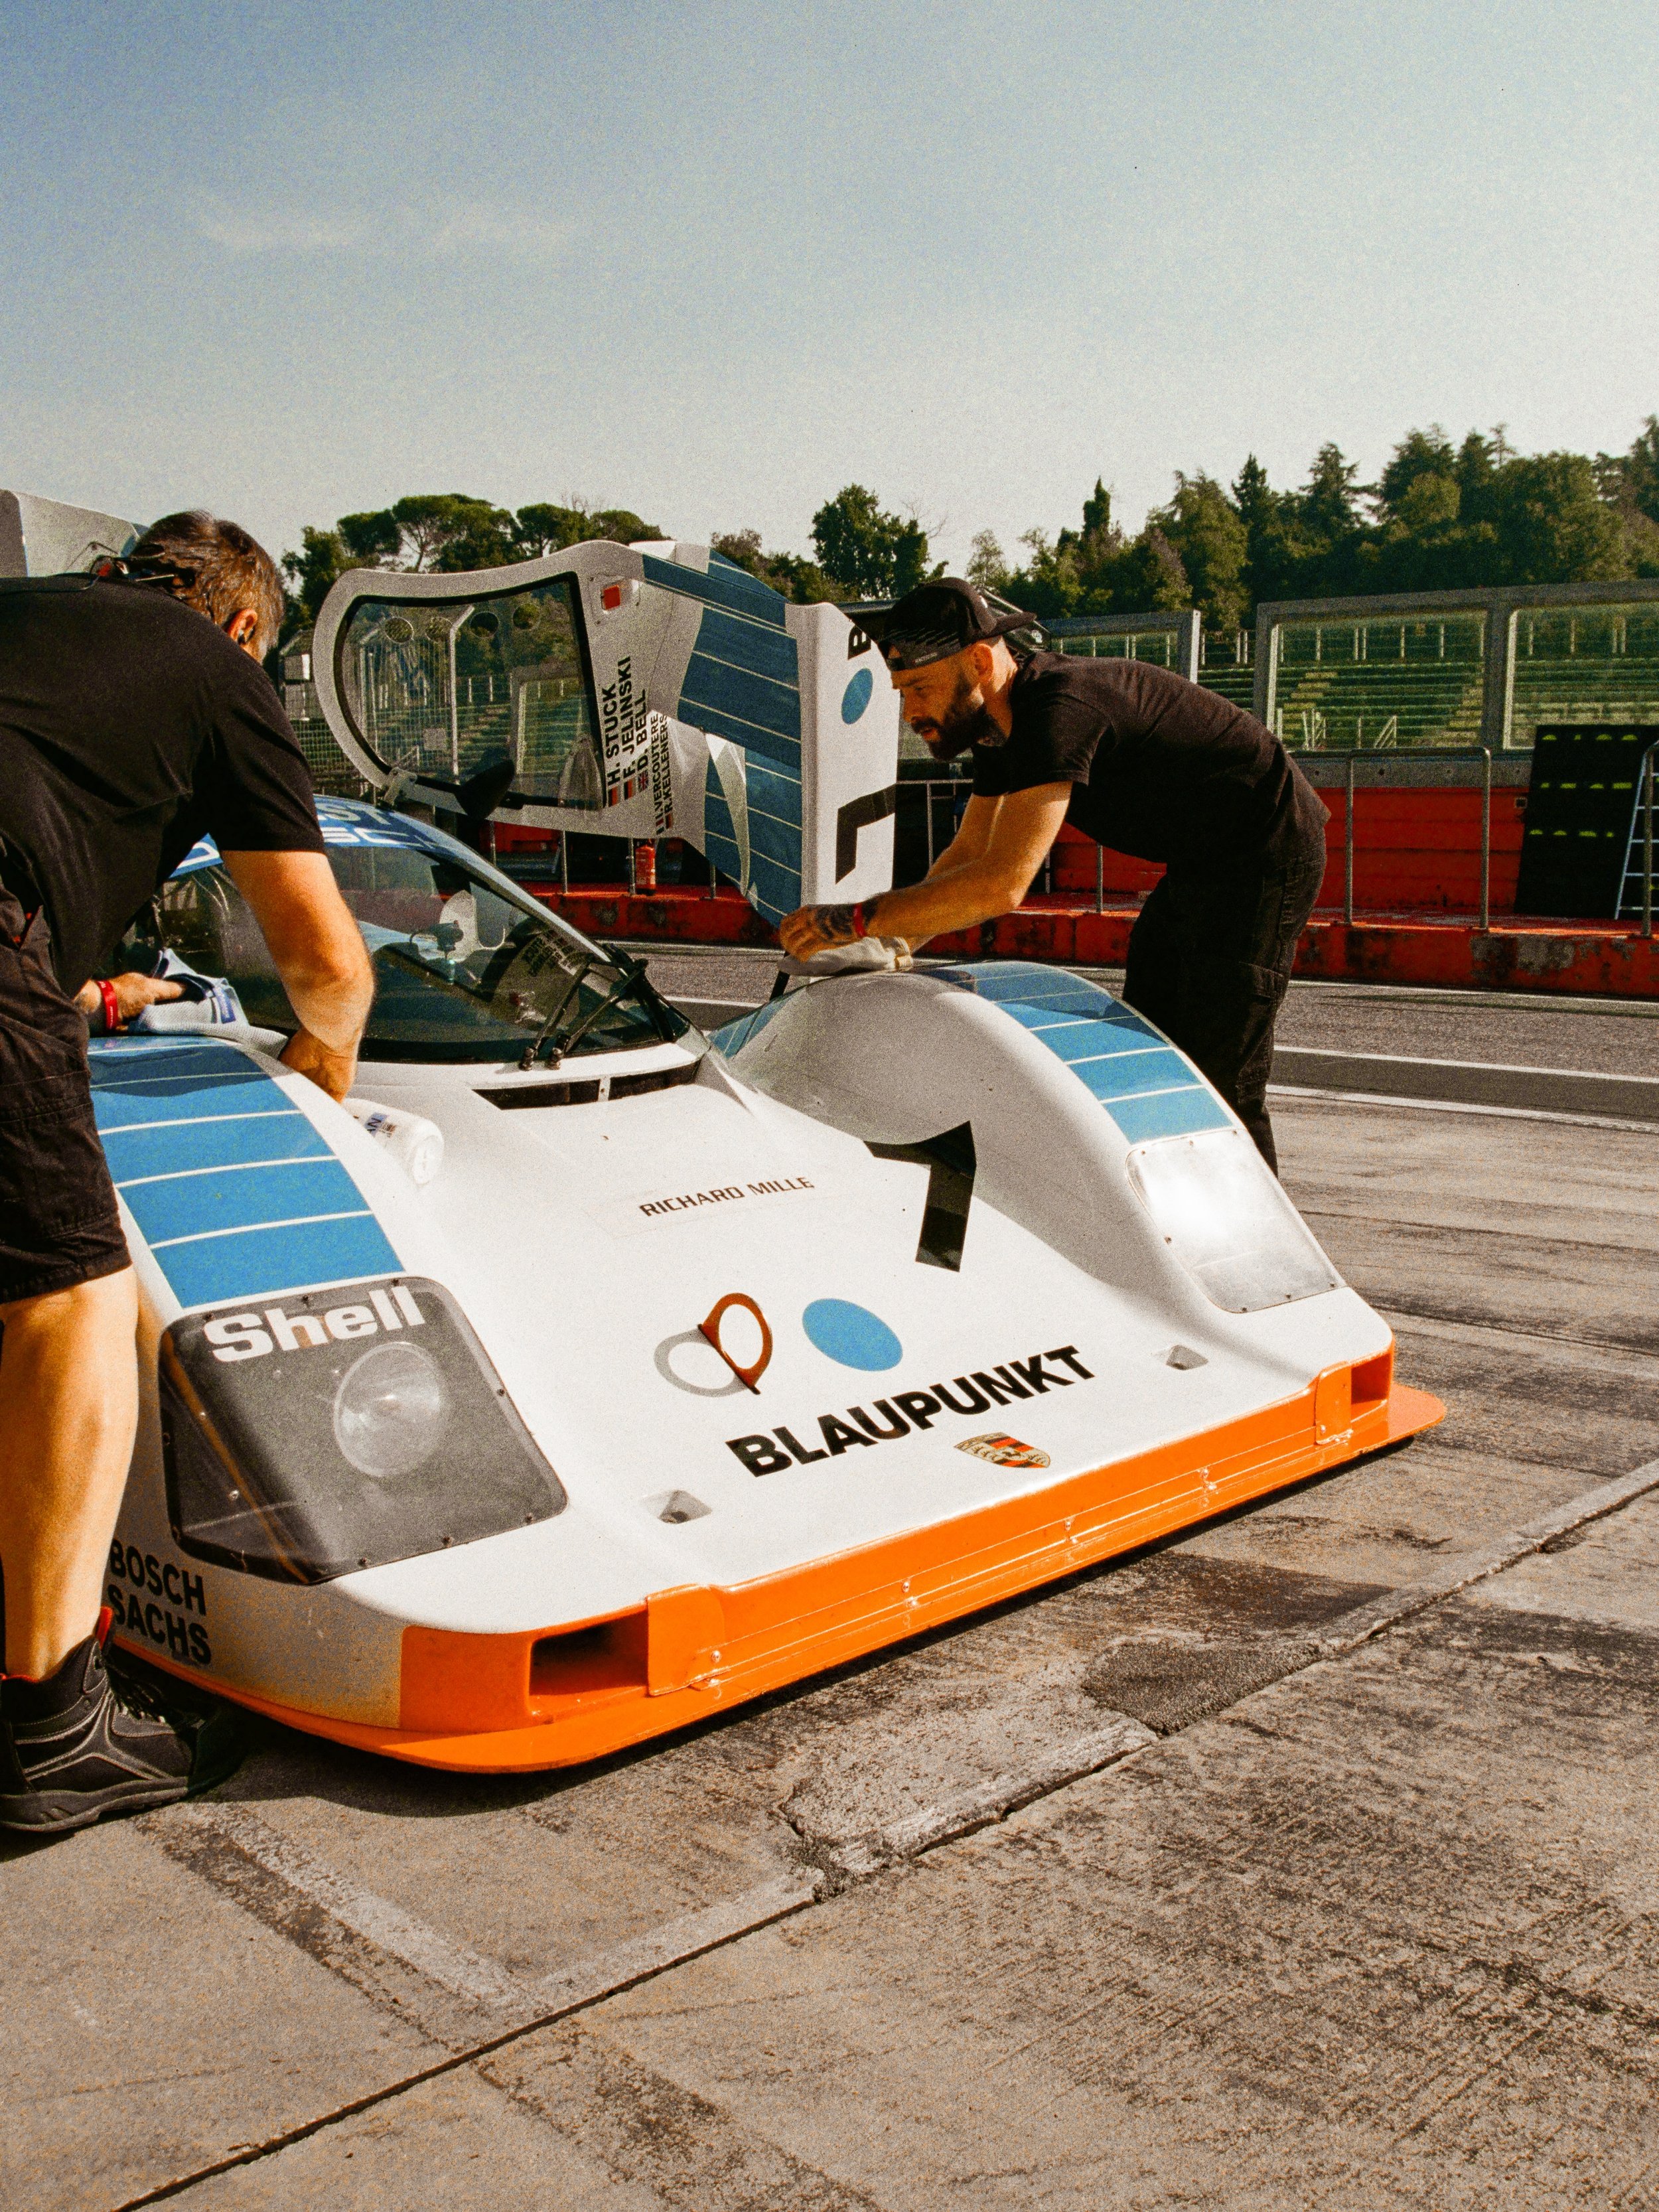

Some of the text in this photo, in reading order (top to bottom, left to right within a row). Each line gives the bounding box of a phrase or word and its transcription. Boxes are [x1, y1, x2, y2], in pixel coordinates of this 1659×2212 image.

[601, 683, 620, 786] H. STUCK
[617, 656, 636, 778] F. JELINSKI
[634, 688, 649, 771] D. BELL
[639, 1177, 816, 1217] RICHARD MILLE
[203, 1286, 426, 1363] Shell
[724, 1345, 1096, 1478] BLAUPUNKT
[109, 1538, 206, 1617] BOSCH
[107, 1584, 212, 1664] SACHS
